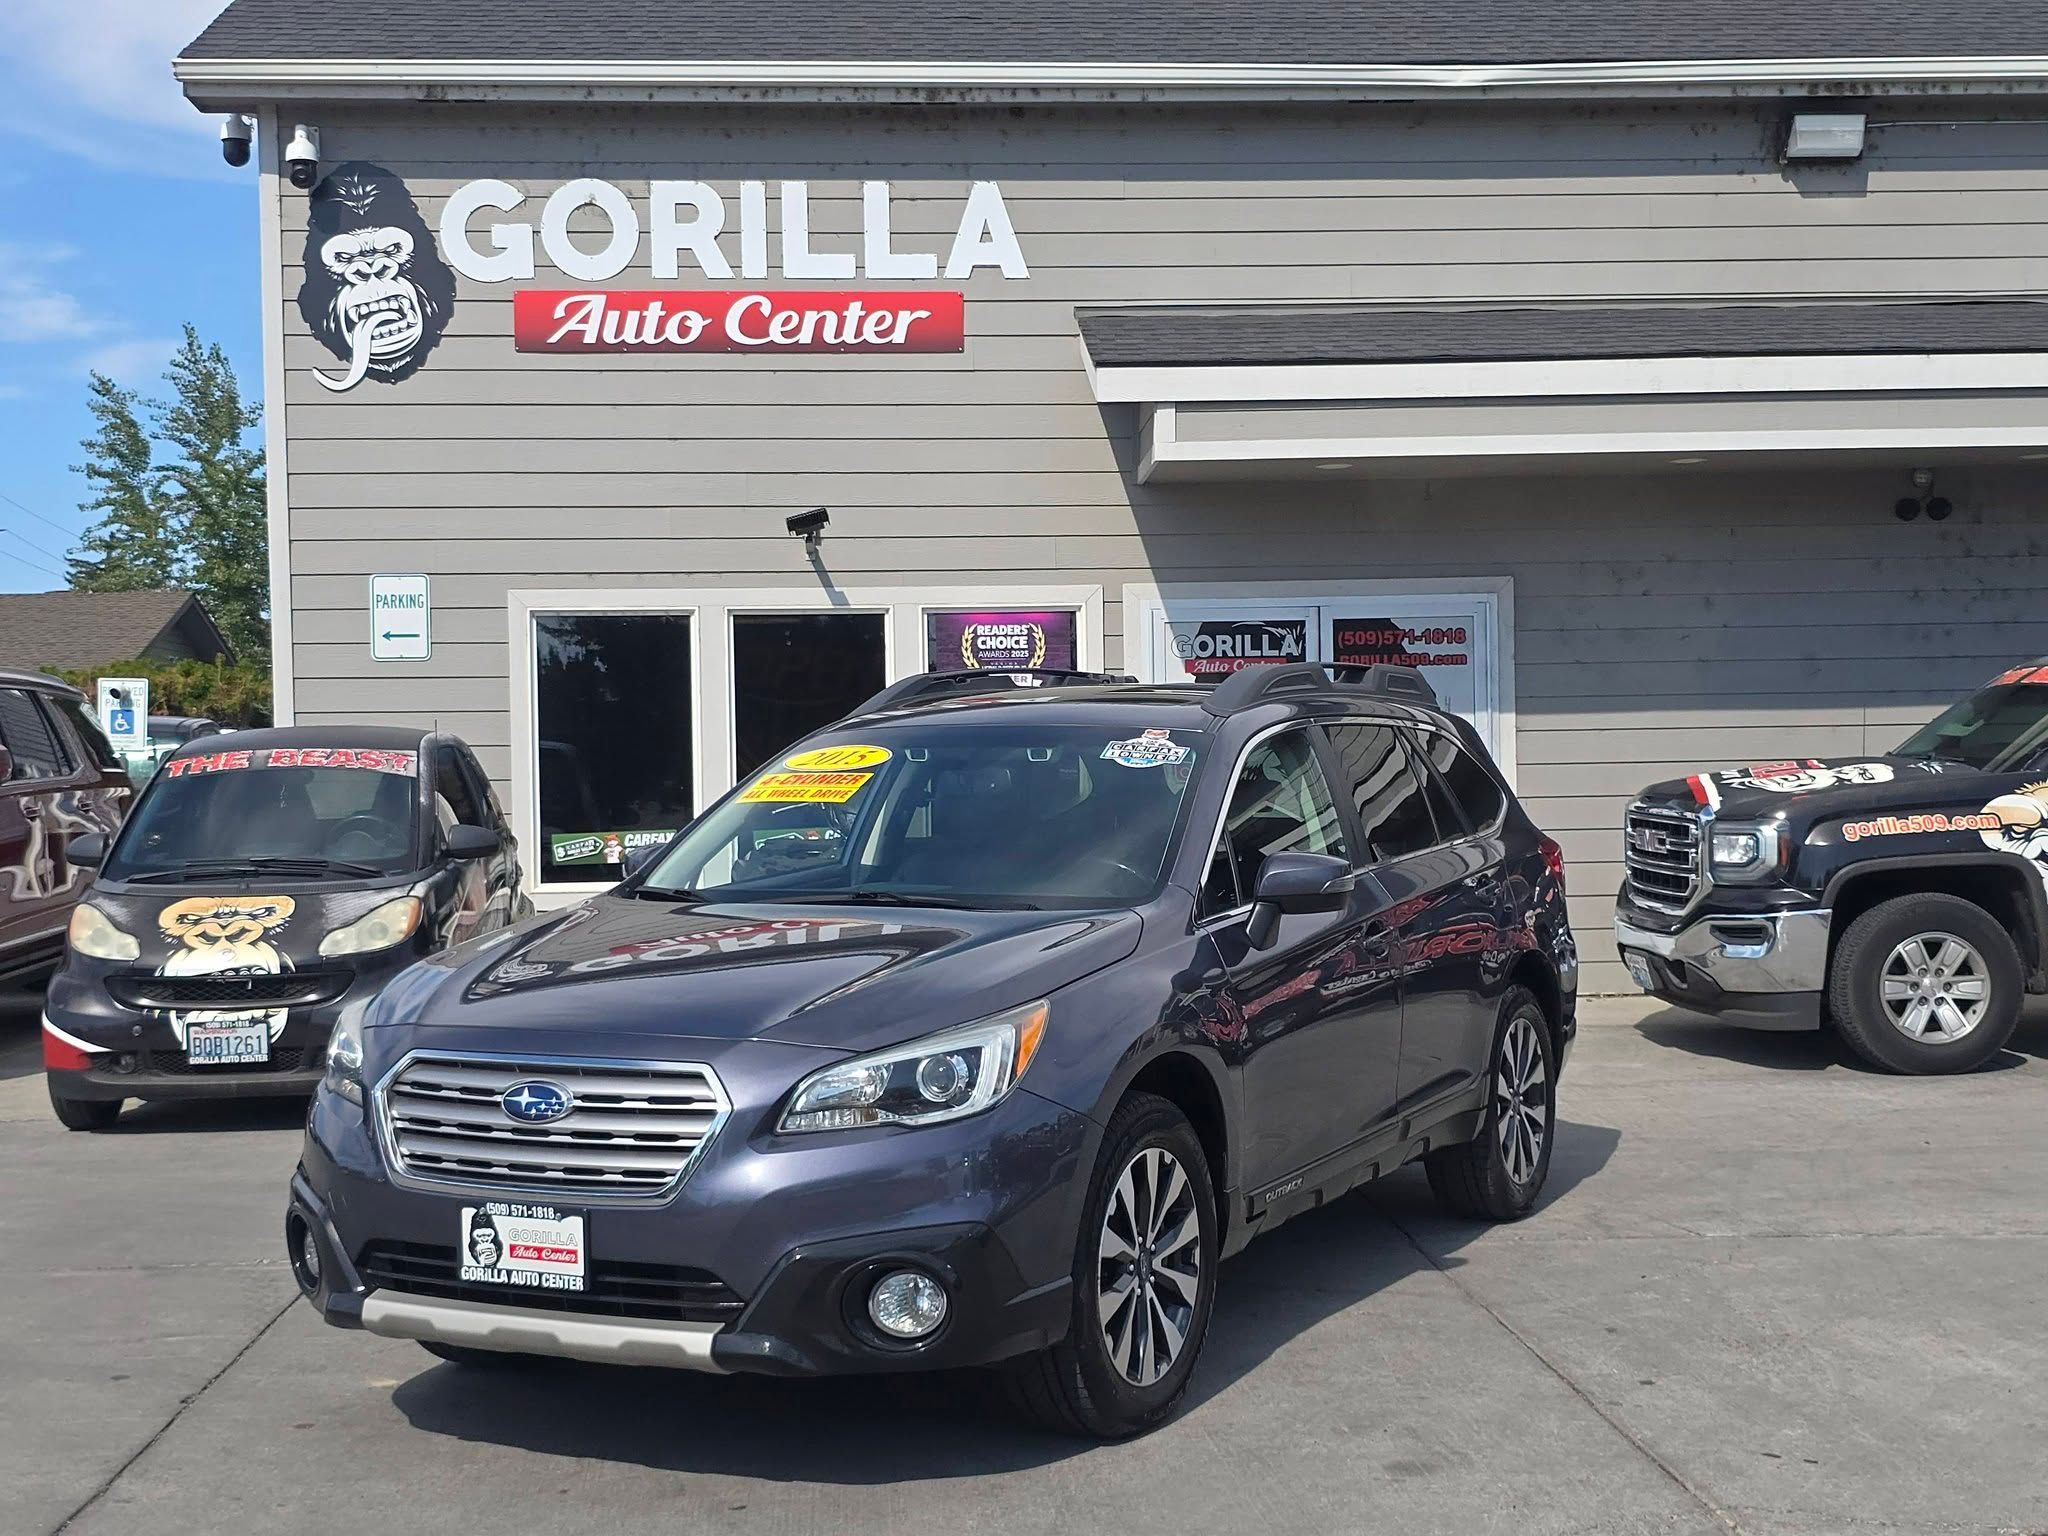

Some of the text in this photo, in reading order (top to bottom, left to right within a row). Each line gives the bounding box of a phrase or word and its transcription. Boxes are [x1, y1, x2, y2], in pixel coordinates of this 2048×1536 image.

[440, 178, 1031, 282] GORILLA
[547, 294, 931, 346] Auto Center
[376, 594, 425, 609] PARKING
[976, 636, 1029, 650] CHOICE
[1171, 634, 1300, 658] GORILLA
[1338, 628, 1467, 648] (509)571-1818
[1010, 650, 1030, 658] 2025
[1193, 660, 1231, 673] Auto
[796, 749, 878, 767] 2015
[1111, 743, 1180, 756] CARFAX
[165, 749, 417, 778] THE BEAST
[743, 788, 852, 799] ALL WHEEL DRIVE
[1843, 814, 2001, 841] gorilla509.com
[624, 832, 675, 847] CARFAX
[1635, 827, 1667, 854] GMC
[193, 1034, 263, 1057] BQB1261
[189, 1054, 269, 1065] GORILLA AUTO CENTER
[486, 1202, 555, 1220] (509) 571-1818
[508, 1227, 579, 1247] GORILLA
[511, 1245, 578, 1263] Auto Center
[461, 1265, 584, 1292] GORILLA AUTO CENTER
